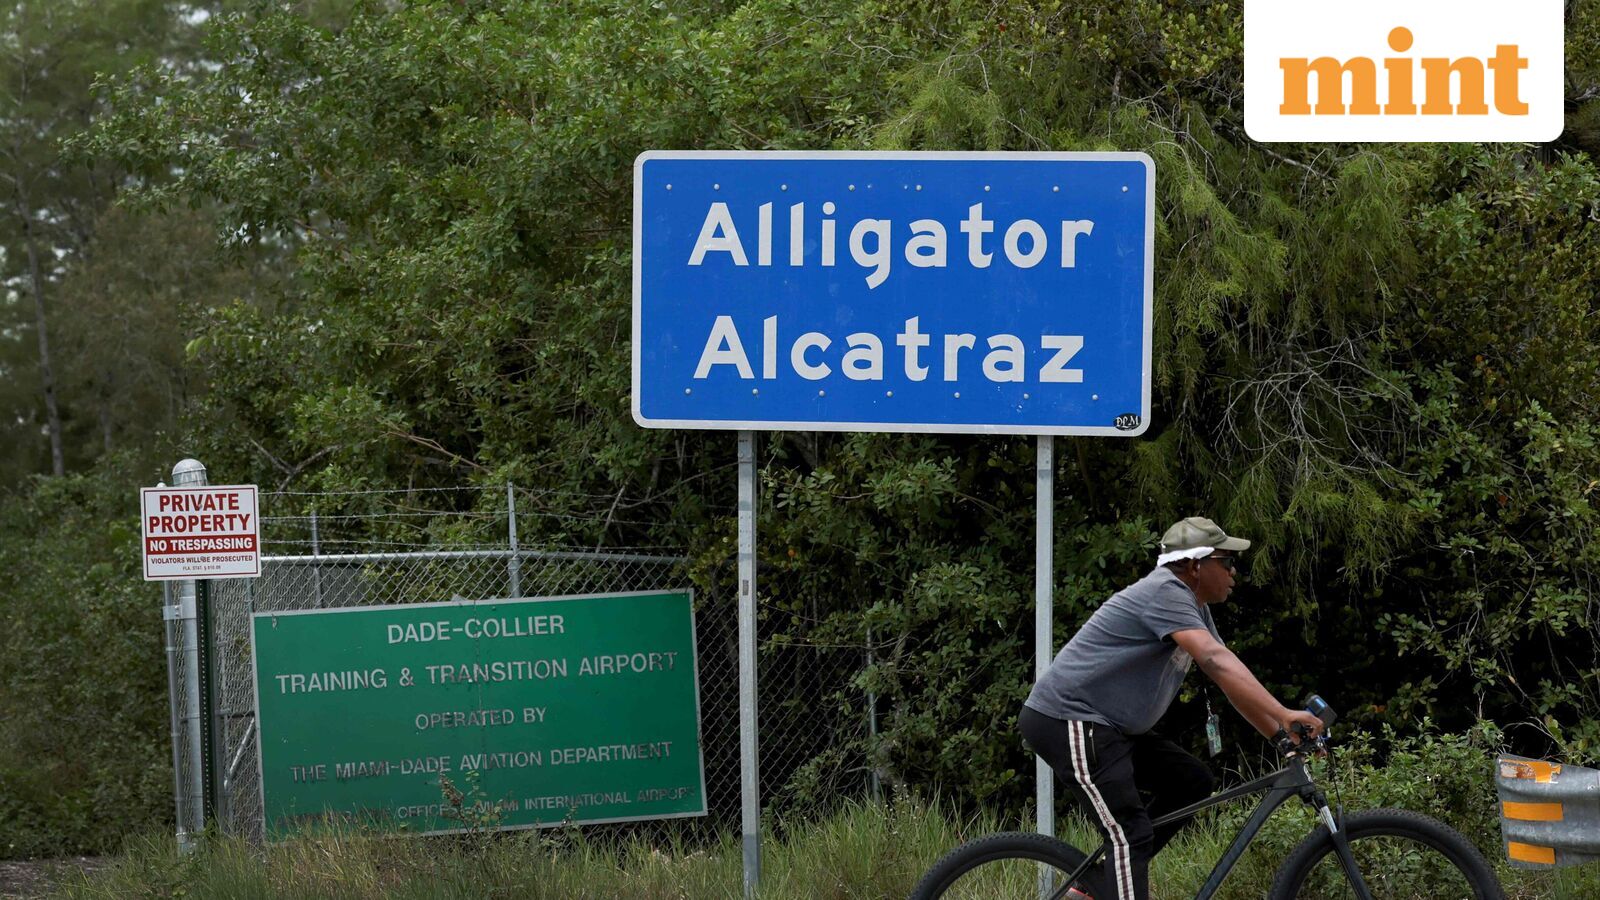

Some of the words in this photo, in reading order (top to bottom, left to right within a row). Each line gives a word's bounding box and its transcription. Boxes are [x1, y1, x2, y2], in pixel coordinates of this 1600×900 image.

[687, 201, 1095, 290] Alligator
[692, 315, 1085, 384] Alcatraz
[159, 493, 240, 512] PRIVATE
[149, 513, 251, 533] PROPERTY
[150, 540, 167, 552] NO
[170, 537, 253, 551] TRESPASSING
[387, 615, 565, 644] DADE-COLLIER
[275, 668, 388, 694] TRAINING
[399, 667, 415, 687] &
[425, 658, 568, 684] TRANSITION
[578, 651, 678, 677] AIRPORT
[415, 709, 515, 730] OPERATED
[523, 707, 547, 724] BY
[290, 764, 327, 783] THE
[335, 756, 451, 779] MIAMI-DADE
[460, 751, 543, 771] AVIATION
[550, 741, 673, 765] DEPARTMENT
[524, 791, 632, 810] INTERNATIONAL
